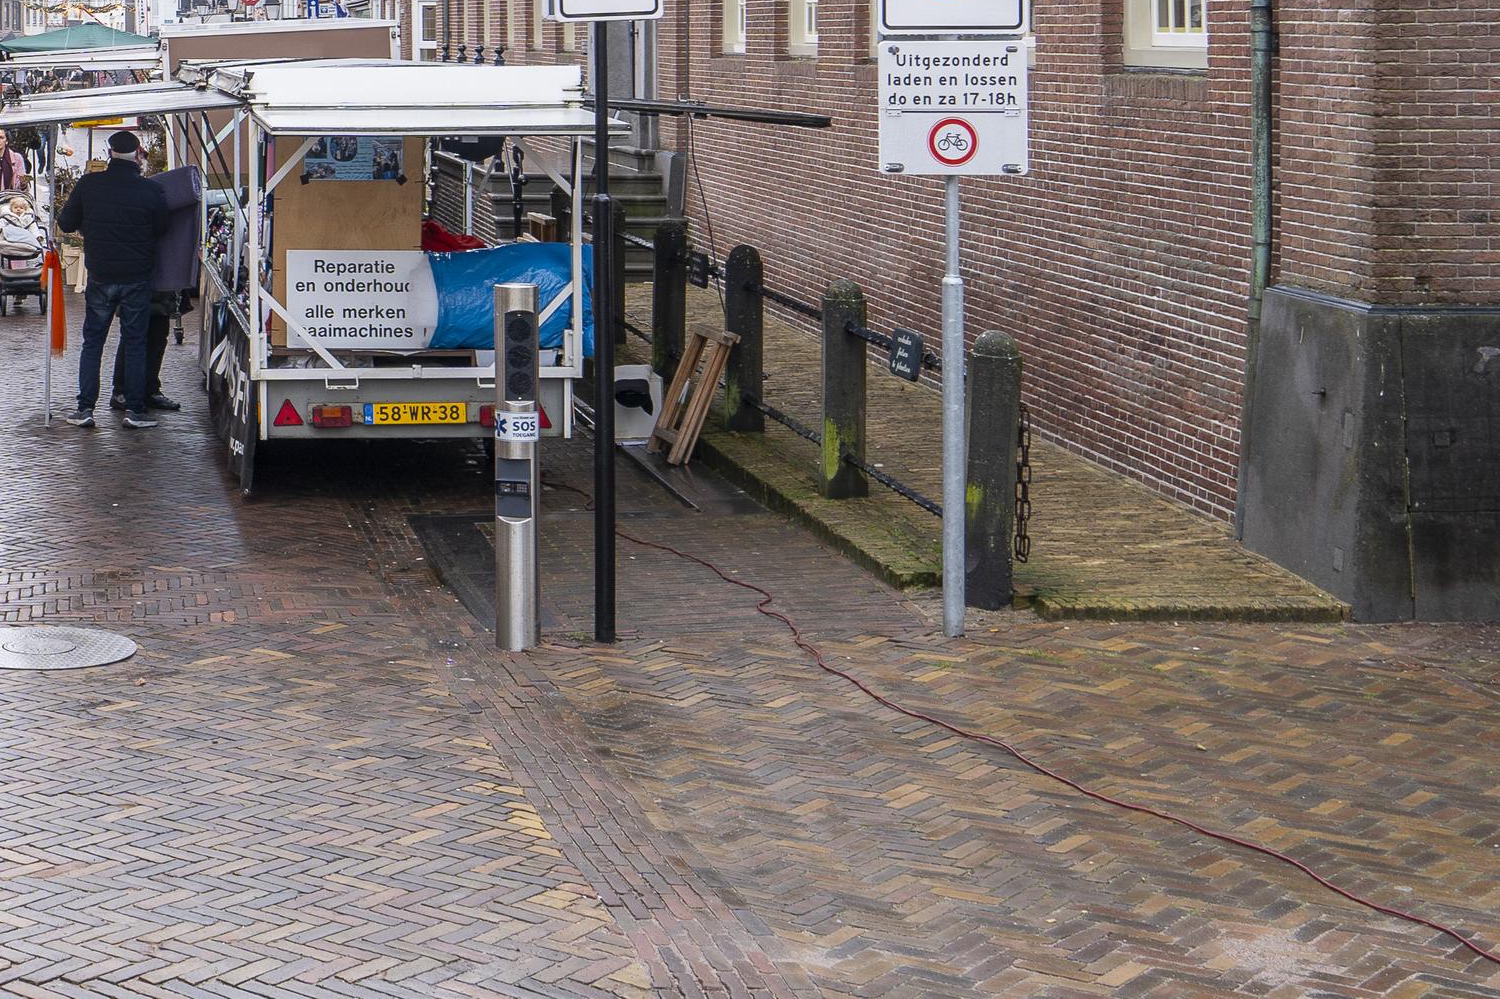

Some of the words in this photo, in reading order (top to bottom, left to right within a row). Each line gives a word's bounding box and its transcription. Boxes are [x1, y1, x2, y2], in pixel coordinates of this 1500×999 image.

[896, 53, 1009, 70] Uitgezonderd
[888, 73, 932, 86] laden
[939, 75, 958, 86] en
[965, 73, 1017, 86] lossen
[888, 92, 907, 105] do
[913, 95, 932, 105] en
[938, 95, 957, 105] za
[963, 92, 1017, 105] 17-18h
[314, 259, 396, 276] Reparatie
[295, 281, 316, 292] en
[305, 305, 335, 318] alle
[342, 305, 406, 318] merken
[379, 404, 460, 422] 58-WR-38
[512, 421, 536, 432] SOS
